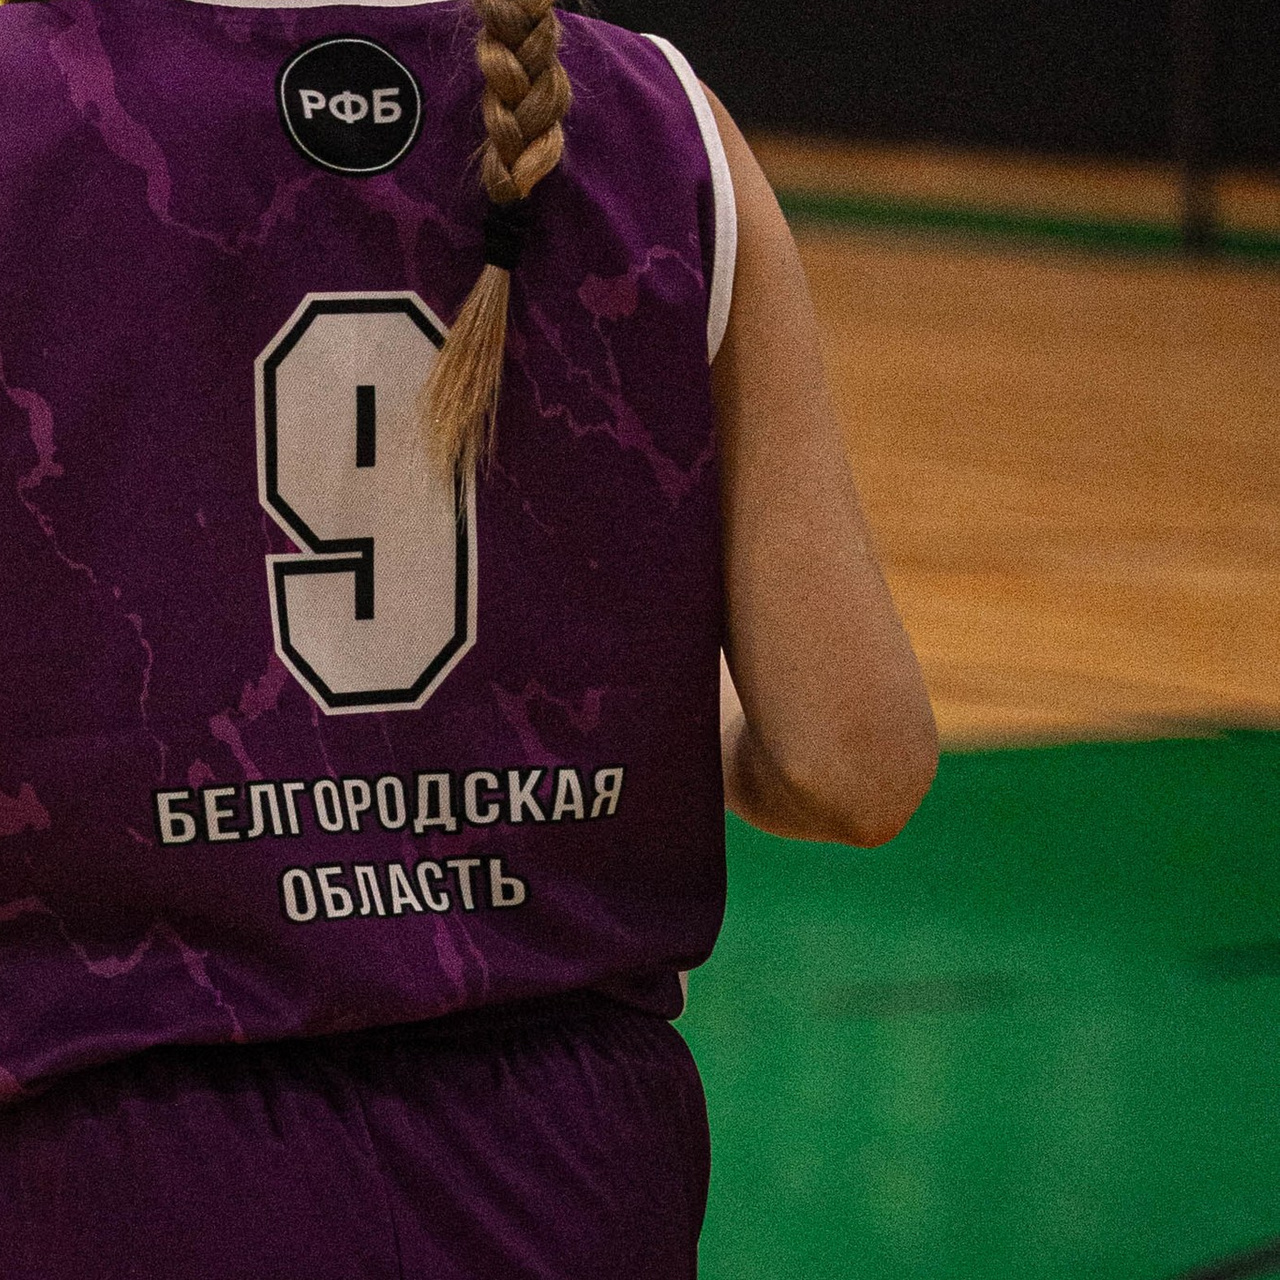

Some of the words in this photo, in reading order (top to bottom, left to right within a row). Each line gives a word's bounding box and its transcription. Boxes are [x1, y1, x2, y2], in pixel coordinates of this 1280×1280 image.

[298, 87, 403, 125] РФБ
[254, 290, 479, 716] 9
[155, 766, 625, 844] БЕЛГОРОДСКАЯ
[280, 857, 528, 923] ОБЛАСТЬ
